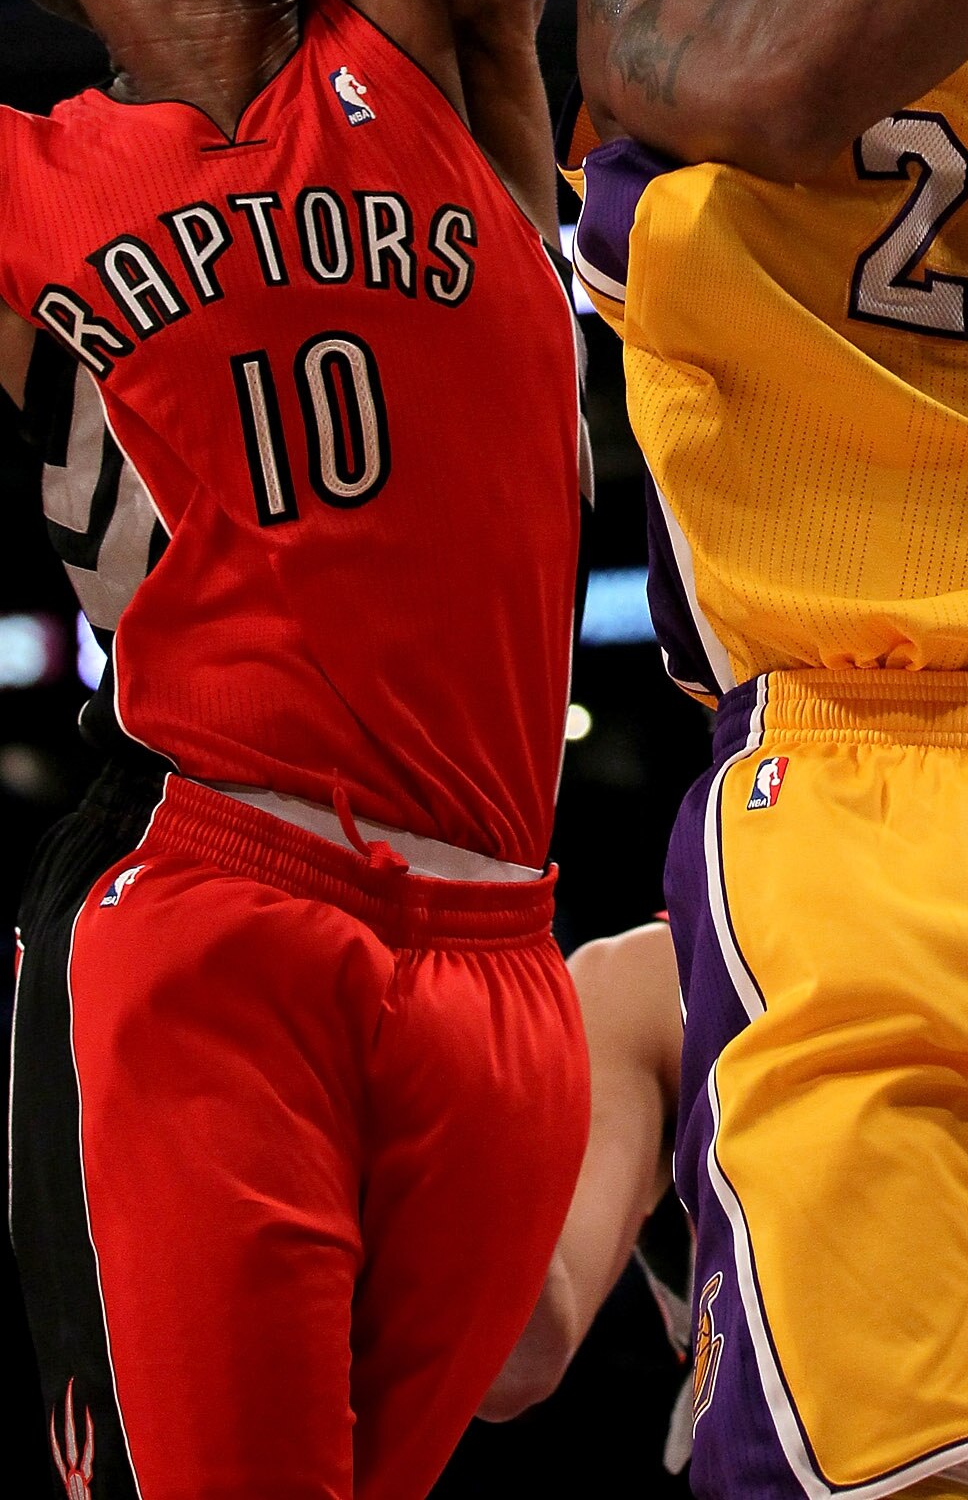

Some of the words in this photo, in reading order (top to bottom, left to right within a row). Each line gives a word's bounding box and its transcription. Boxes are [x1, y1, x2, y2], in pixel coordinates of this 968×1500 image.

[348, 108, 371, 125] NBA
[31, 186, 479, 380] RAPTORS
[230, 330, 392, 527] 10
[747, 796, 768, 809] NBA
